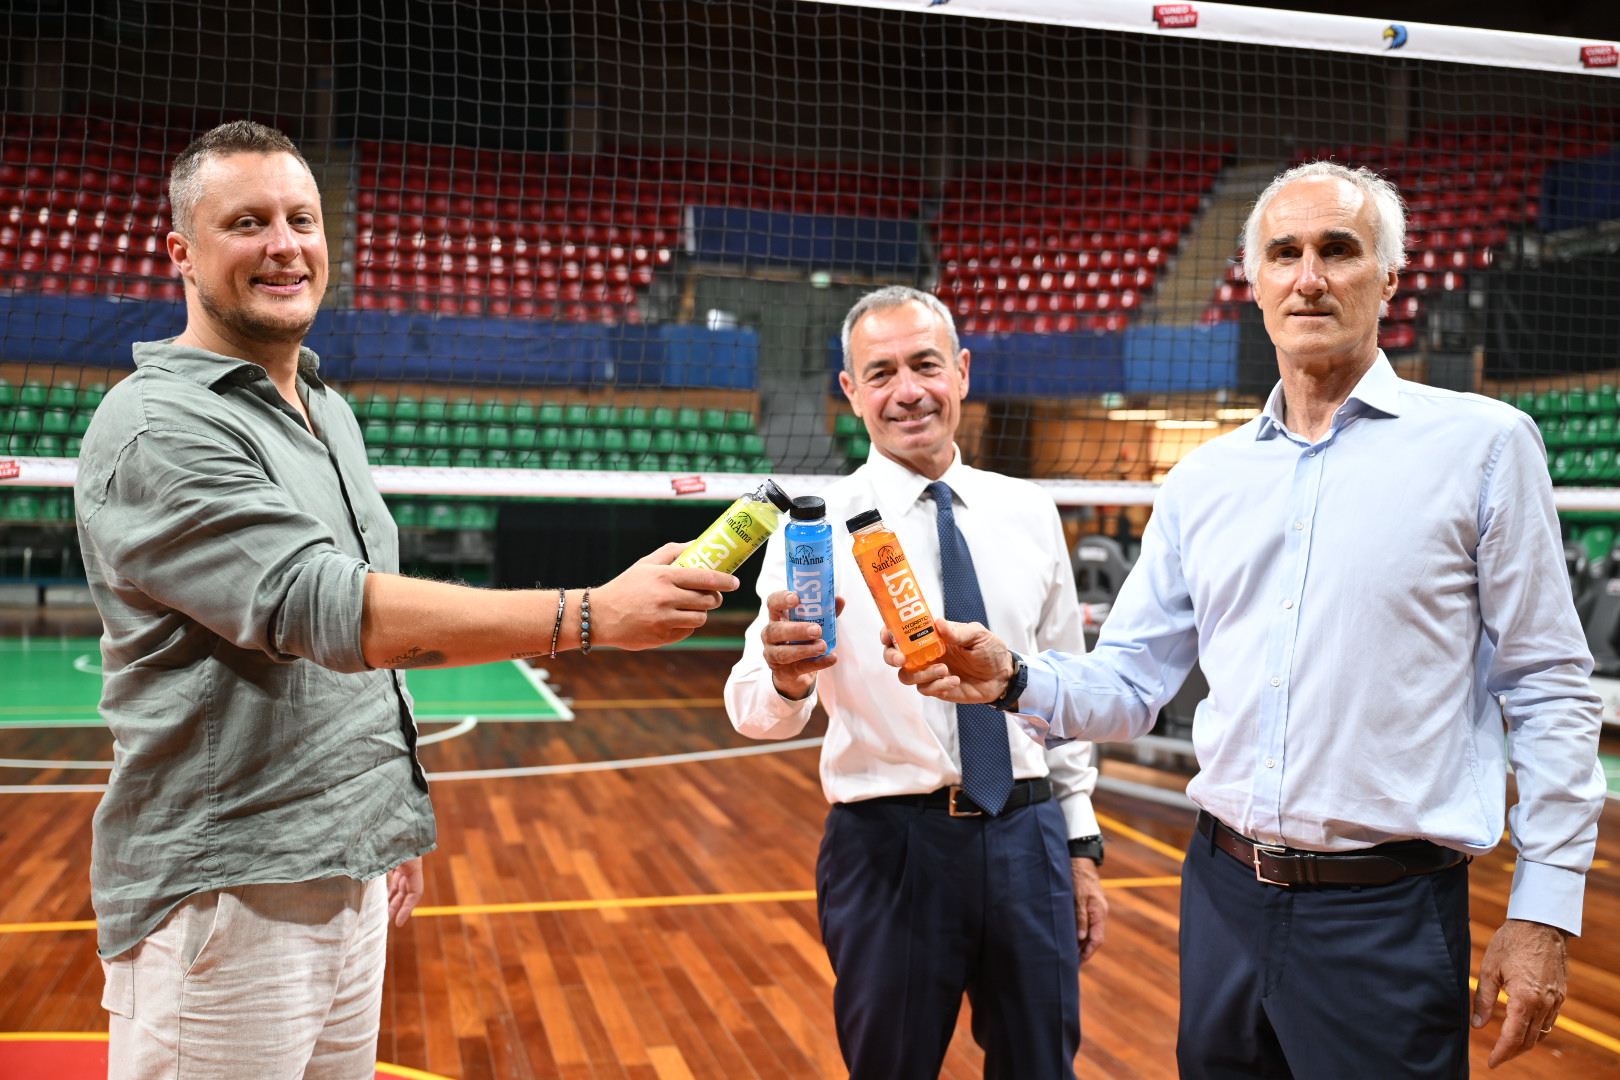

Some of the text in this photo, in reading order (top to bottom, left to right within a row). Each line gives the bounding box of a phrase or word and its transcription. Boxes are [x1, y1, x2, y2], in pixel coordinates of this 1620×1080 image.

[1158, 6, 1188, 15] CUNEO
[1163, 14, 1195, 25] VOLLEY
[788, 552, 824, 565] Sant'Anna
[792, 566, 823, 617] BEST
[881, 568, 926, 623] BEST
